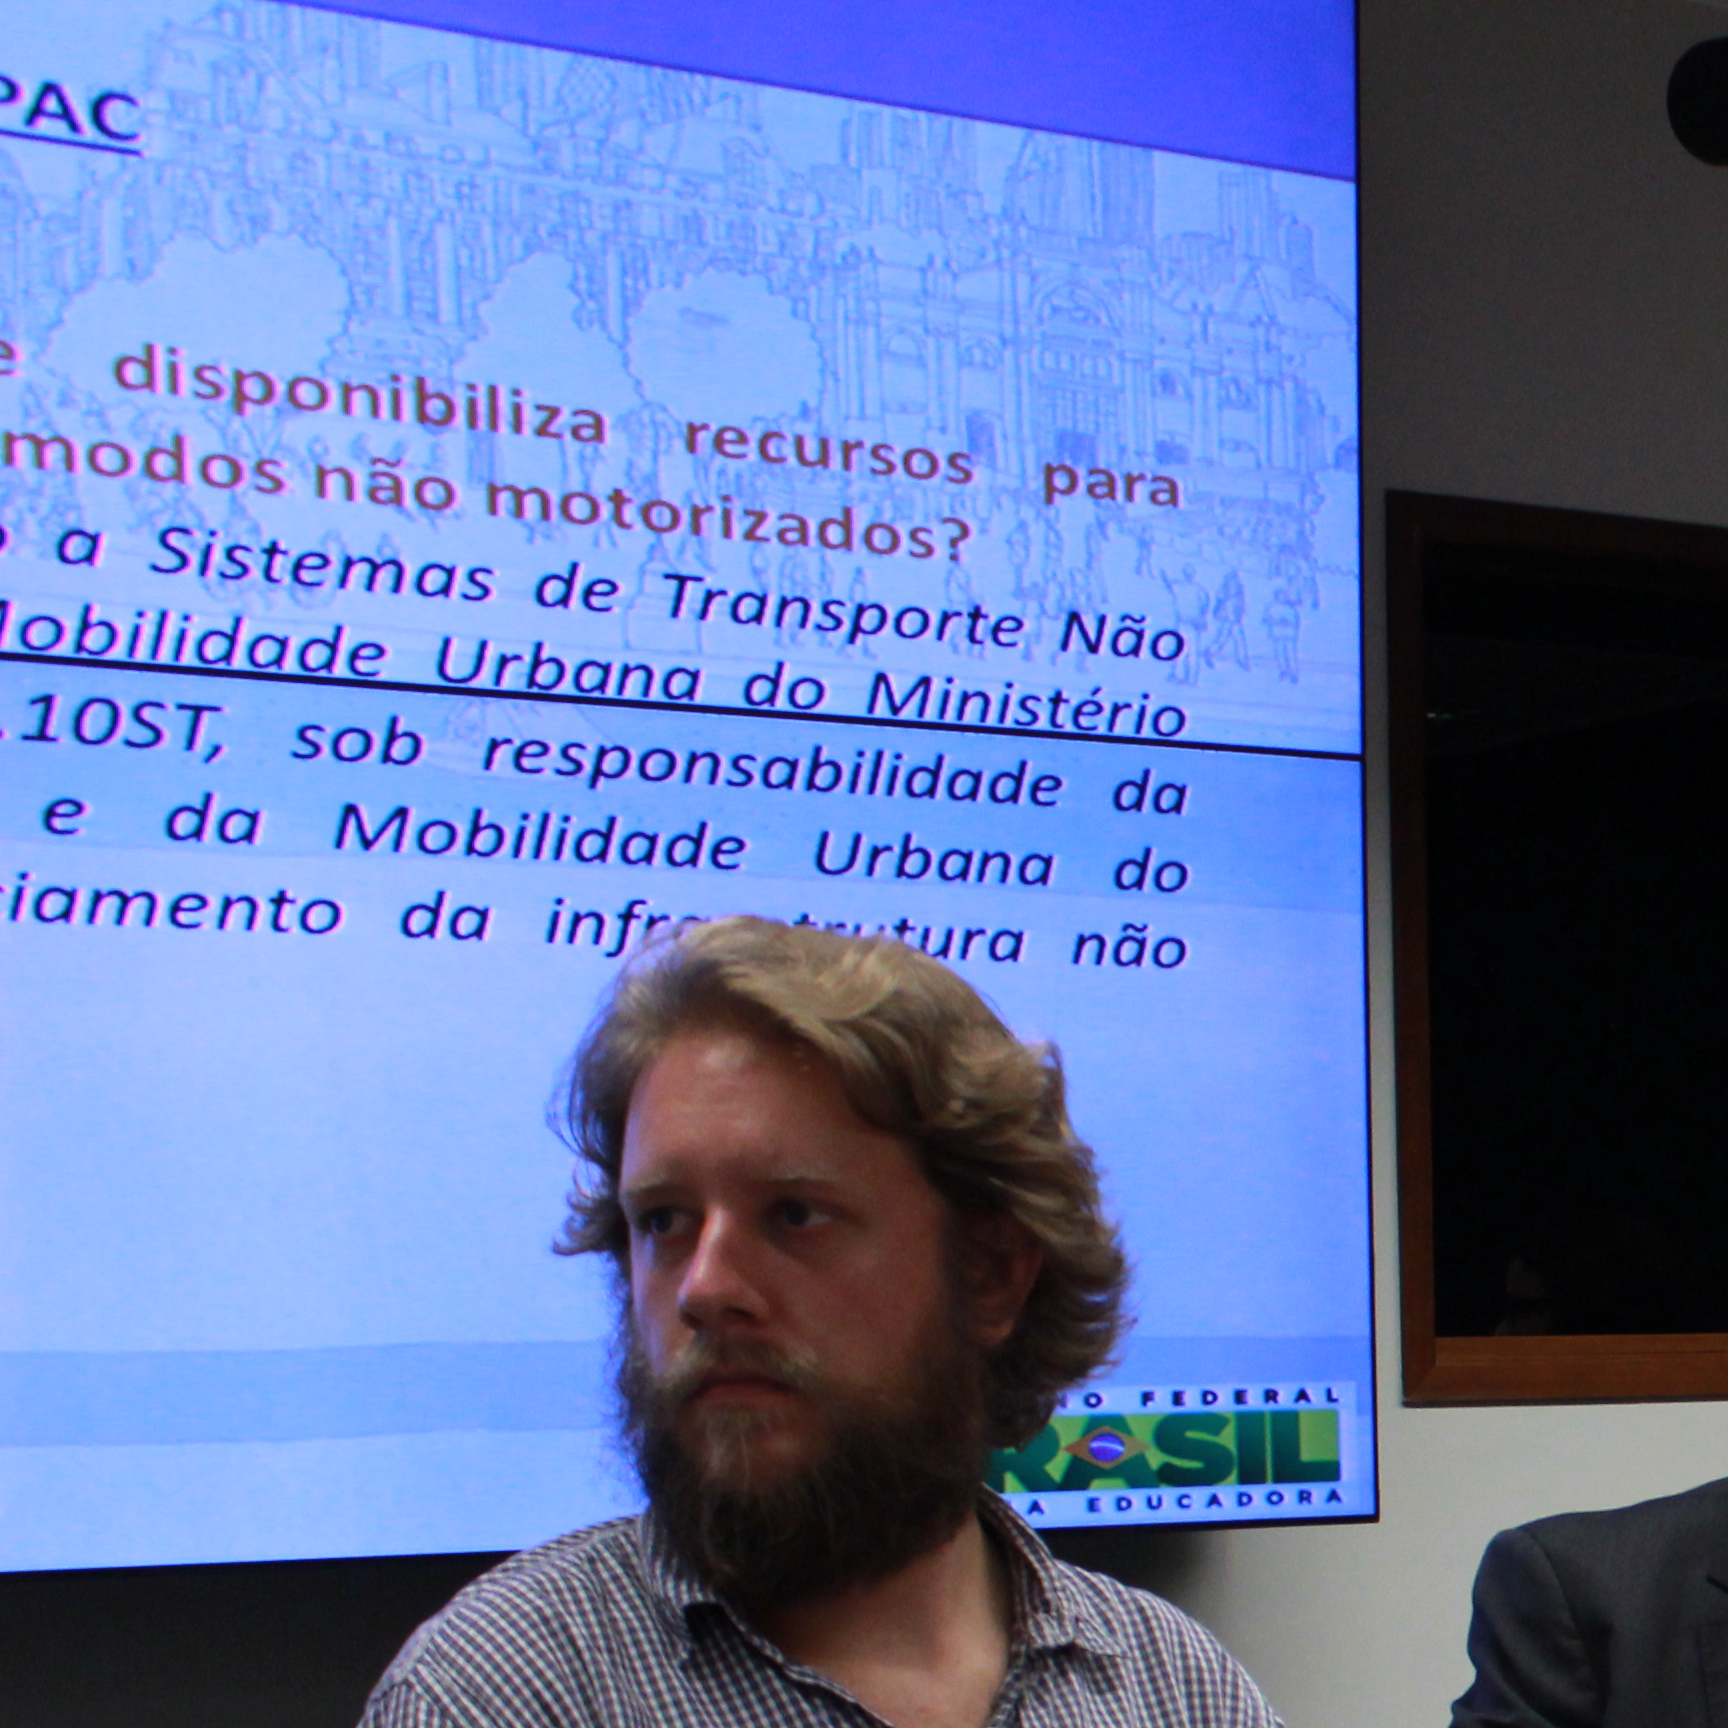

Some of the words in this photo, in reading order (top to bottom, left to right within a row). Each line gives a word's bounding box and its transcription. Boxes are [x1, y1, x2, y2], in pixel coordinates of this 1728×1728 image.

[114, 342, 608, 445] disponibiliza
[685, 421, 975, 486] recursos
[1043, 462, 1181, 507] para
[4, 429, 288, 494] modos
[316, 457, 457, 511] não
[487, 480, 971, 561] motorizados?
[57, 529, 105, 568] a
[150, 526, 497, 603] Sistemas
[535, 561, 621, 613] de
[663, 573, 1025, 648] Transporte
[1060, 611, 1185, 662] Não
[0, 601, 388, 679] obilidade
[437, 635, 702, 702] Urbana
[743, 661, 827, 710] do
[867, 672, 1187, 738] Ministério
[292, 715, 425, 766] sob
[484, 735, 1064, 808] responsabilidade
[1114, 768, 1188, 815] da
[43, 796, 88, 836] e
[166, 792, 263, 847] da
[336, 802, 747, 871] Mobilidade
[816, 830, 1055, 887] Urbana
[1115, 847, 1188, 894] do
[0, 872, 342, 936] iamento
[402, 890, 492, 942] da
[546, 898, 1025, 963] infrtura
[1072, 923, 1188, 970] não
[1141, 1386, 1340, 1409] FEDERAL
[983, 1409, 1341, 1493] RASIL
[1087, 1488, 1343, 1514] EDUCADORA
